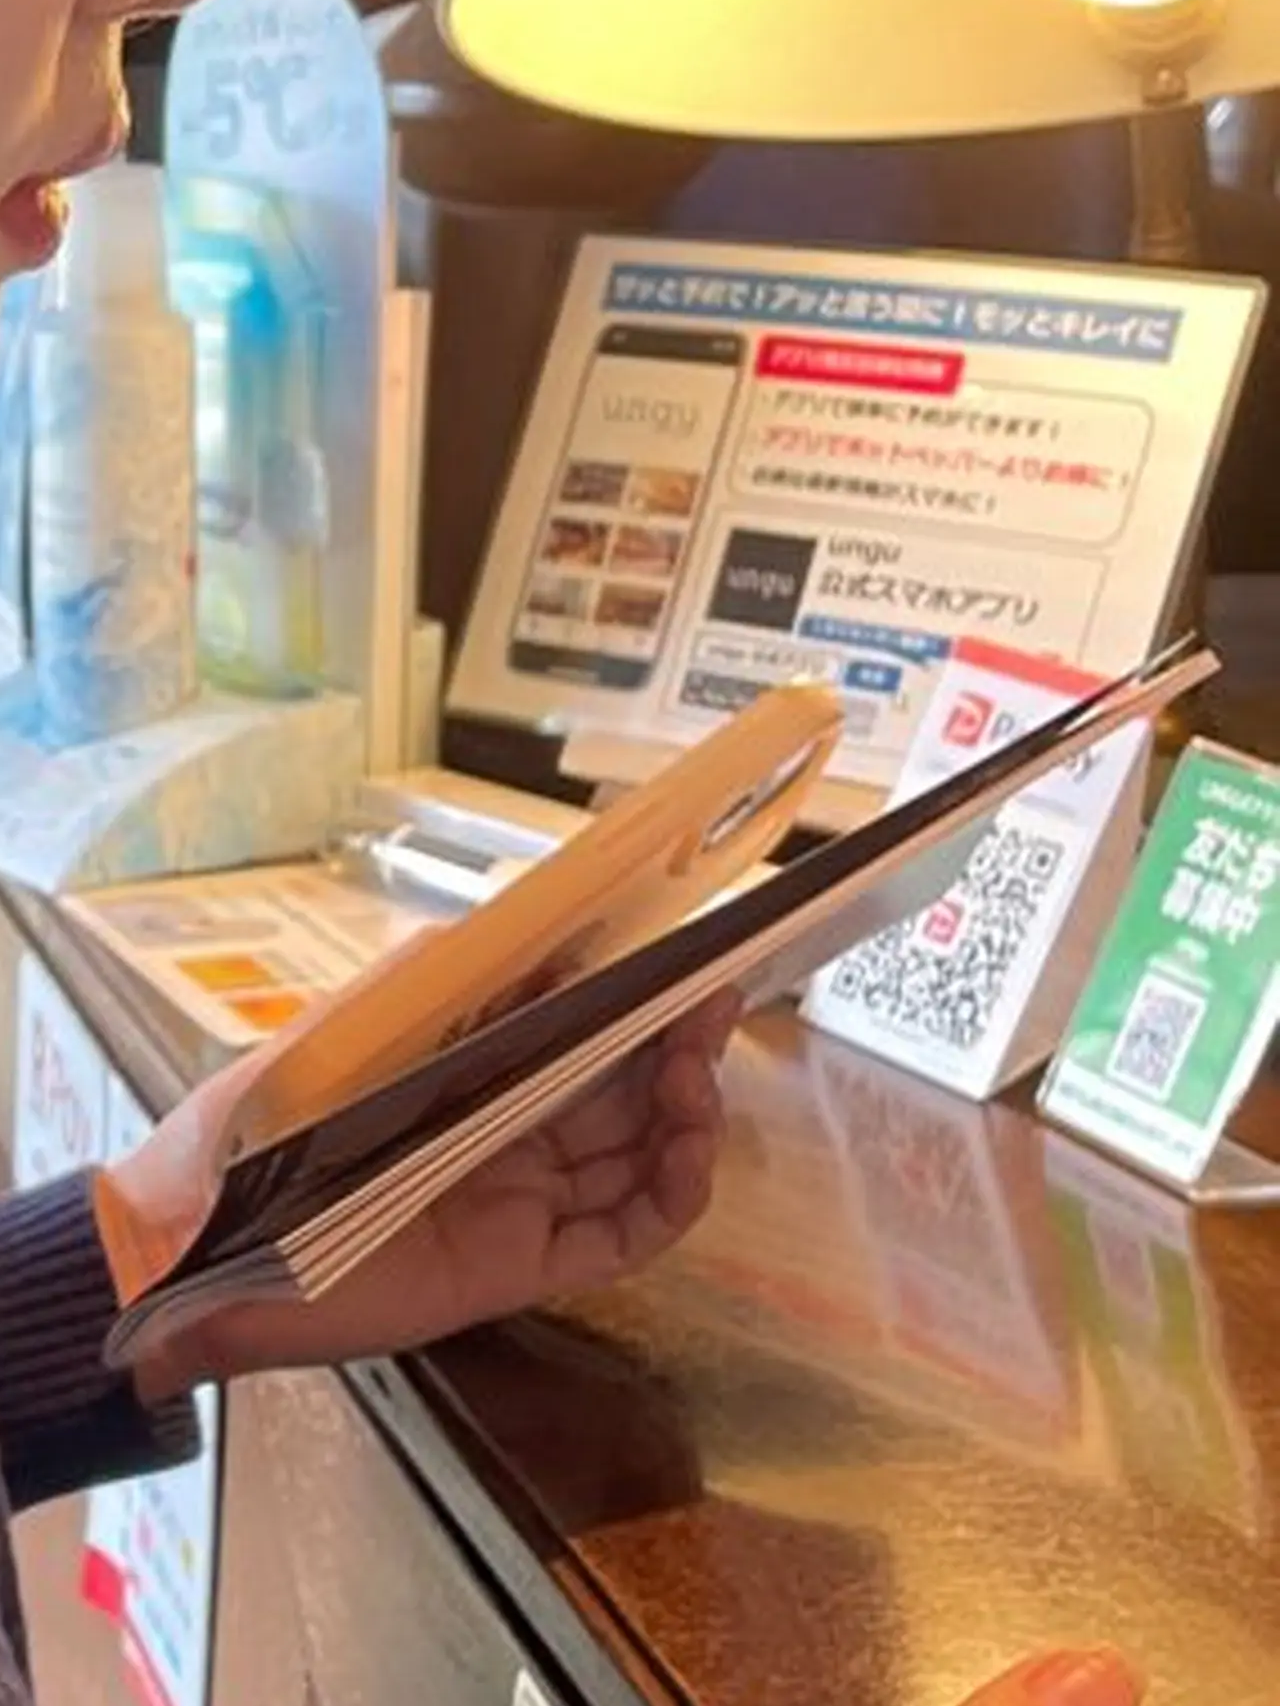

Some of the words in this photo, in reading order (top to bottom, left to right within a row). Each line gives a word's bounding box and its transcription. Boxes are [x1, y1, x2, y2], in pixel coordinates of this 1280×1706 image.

[826, 534, 902, 570] ungu
[816, 566, 1041, 625] 公式スマホアプリ
